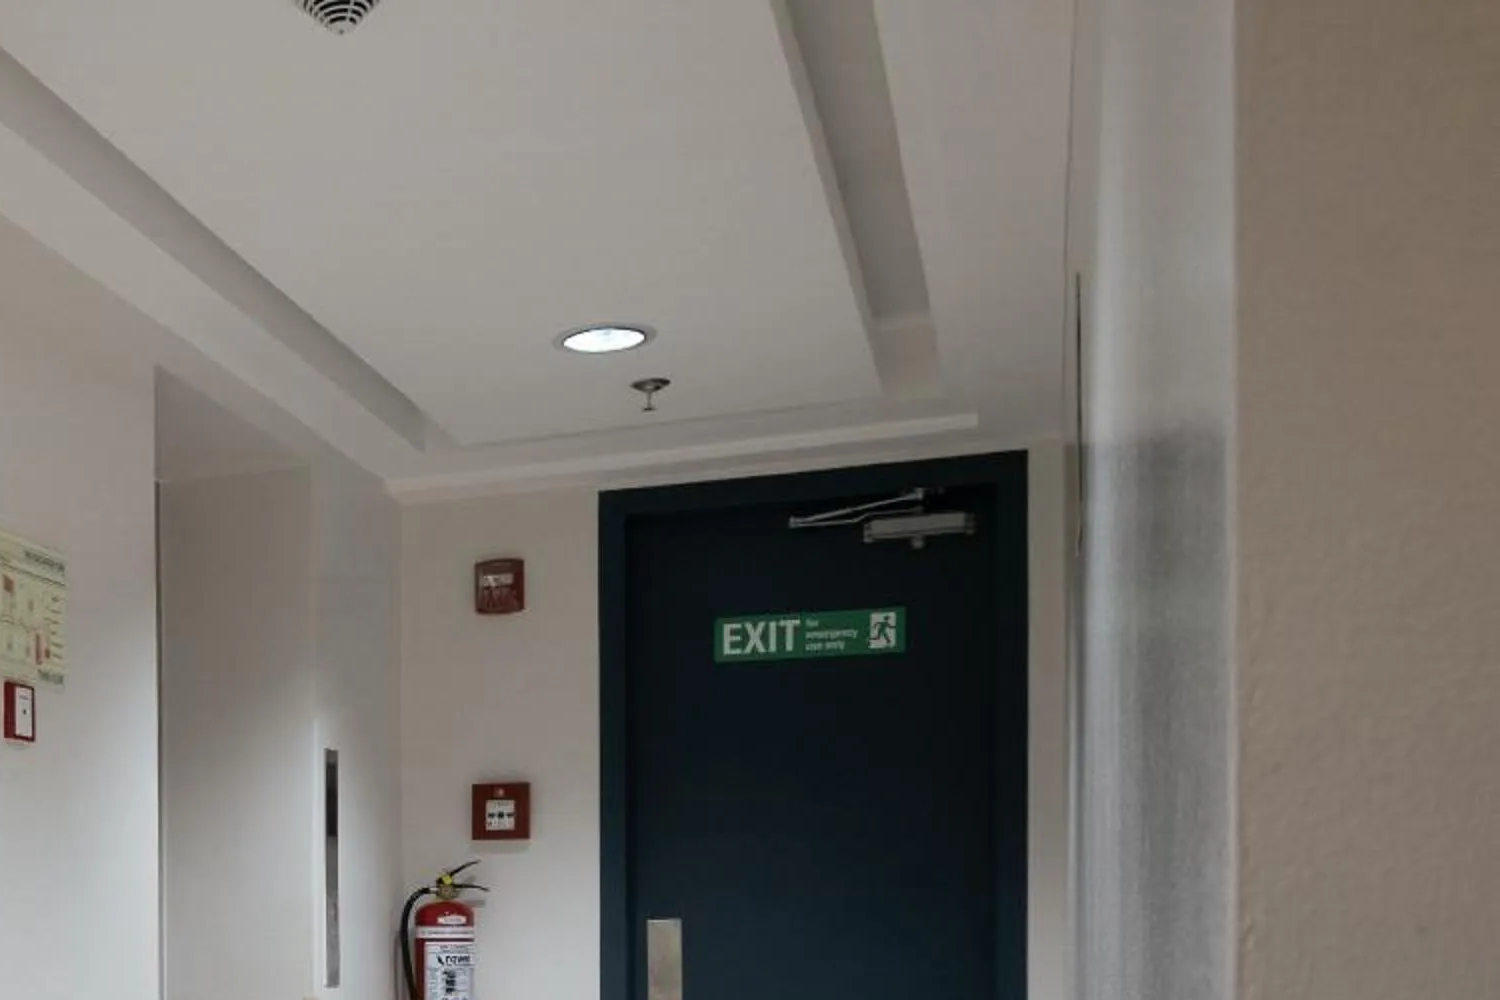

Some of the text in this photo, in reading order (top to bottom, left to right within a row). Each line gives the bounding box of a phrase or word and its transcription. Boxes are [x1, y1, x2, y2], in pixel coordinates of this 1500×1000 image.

[723, 619, 801, 656] EXIT
[805, 628, 858, 640] emergency
[805, 641, 846, 652] use only
